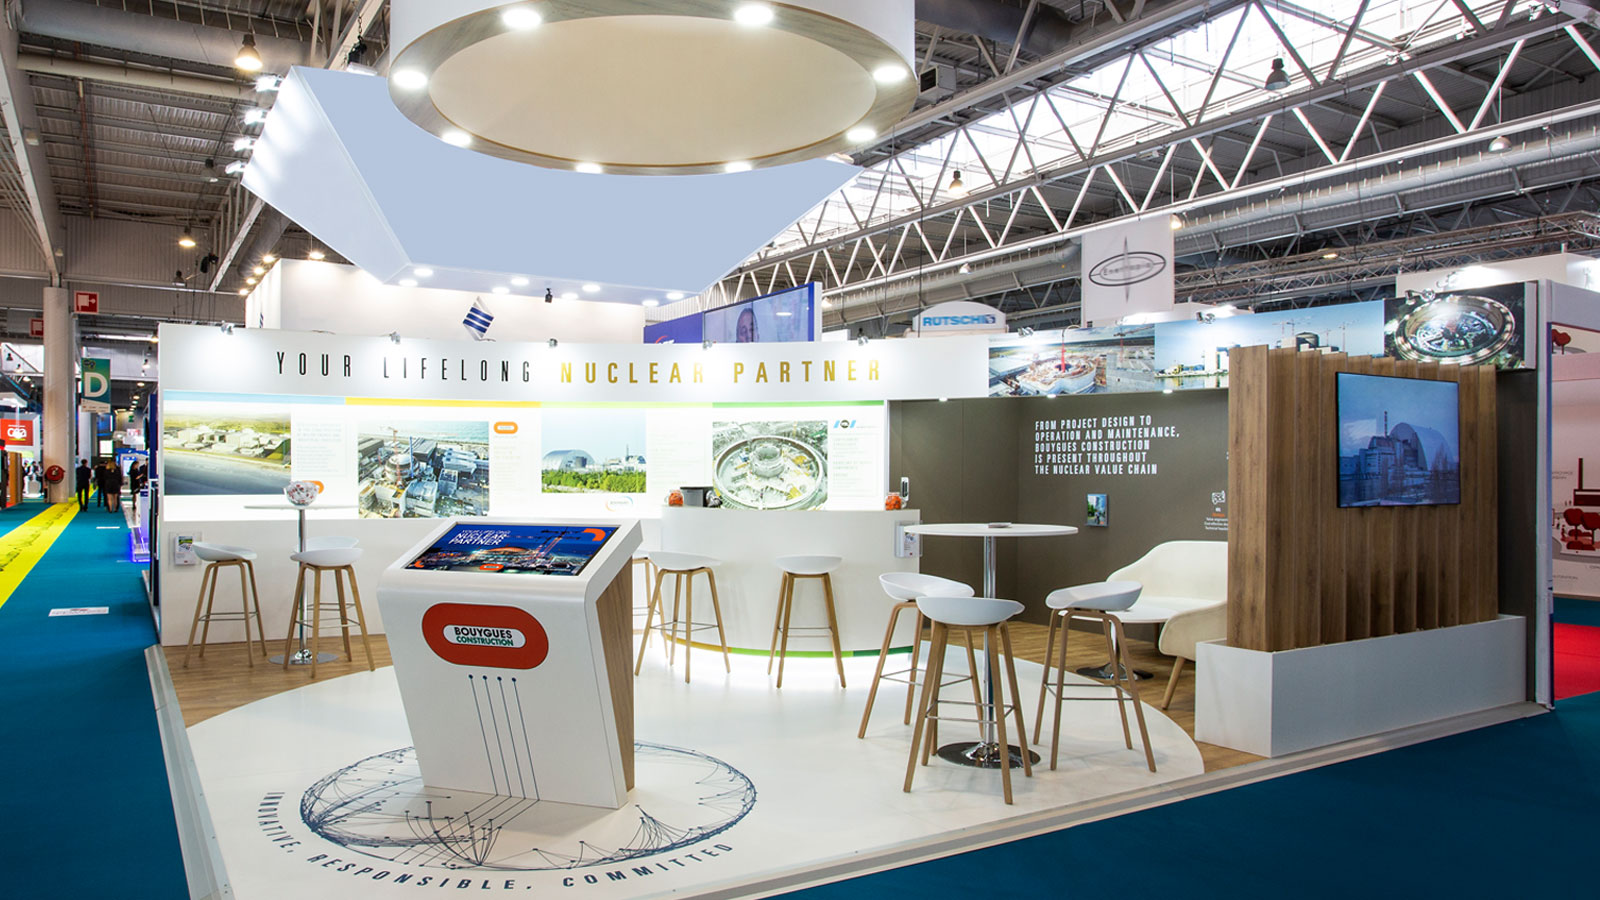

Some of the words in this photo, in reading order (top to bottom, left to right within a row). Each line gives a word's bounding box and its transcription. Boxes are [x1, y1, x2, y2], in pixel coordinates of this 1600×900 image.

[276, 351, 352, 377] YOUR
[383, 357, 531, 382] LIFELONG
[560, 362, 704, 384] NUCLEAR
[733, 359, 880, 383] PARTNER
[84, 372, 108, 397] D
[1035, 420, 1057, 430] FROM
[1060, 418, 1098, 429] PROJECT
[1101, 416, 1135, 427] DESIGN
[1139, 415, 1152, 426] TO
[1035, 430, 1081, 441] OPERATION
[1085, 429, 1103, 439] AND
[1107, 426, 1180, 439] MAINTENANCE,
[1035, 442, 1077, 452] BOUYGUES
[1081, 440, 1150, 452] CONSTRUCTION
[1035, 454, 1043, 463] IS
[1046, 453, 1083, 463] PRESENT
[1087, 452, 1147, 463] THROUGHOUT
[1035, 465, 1049, 475] THE
[1053, 465, 1090, 475] NUCLEAR
[1094, 464, 1124, 475] VALUE
[1127, 464, 1158, 475] CHAIN
[454, 627, 513, 639] BOUYGUES
[456, 636, 514, 646] CONSTRUCTION
[562, 843, 734, 887] COMMITTED
